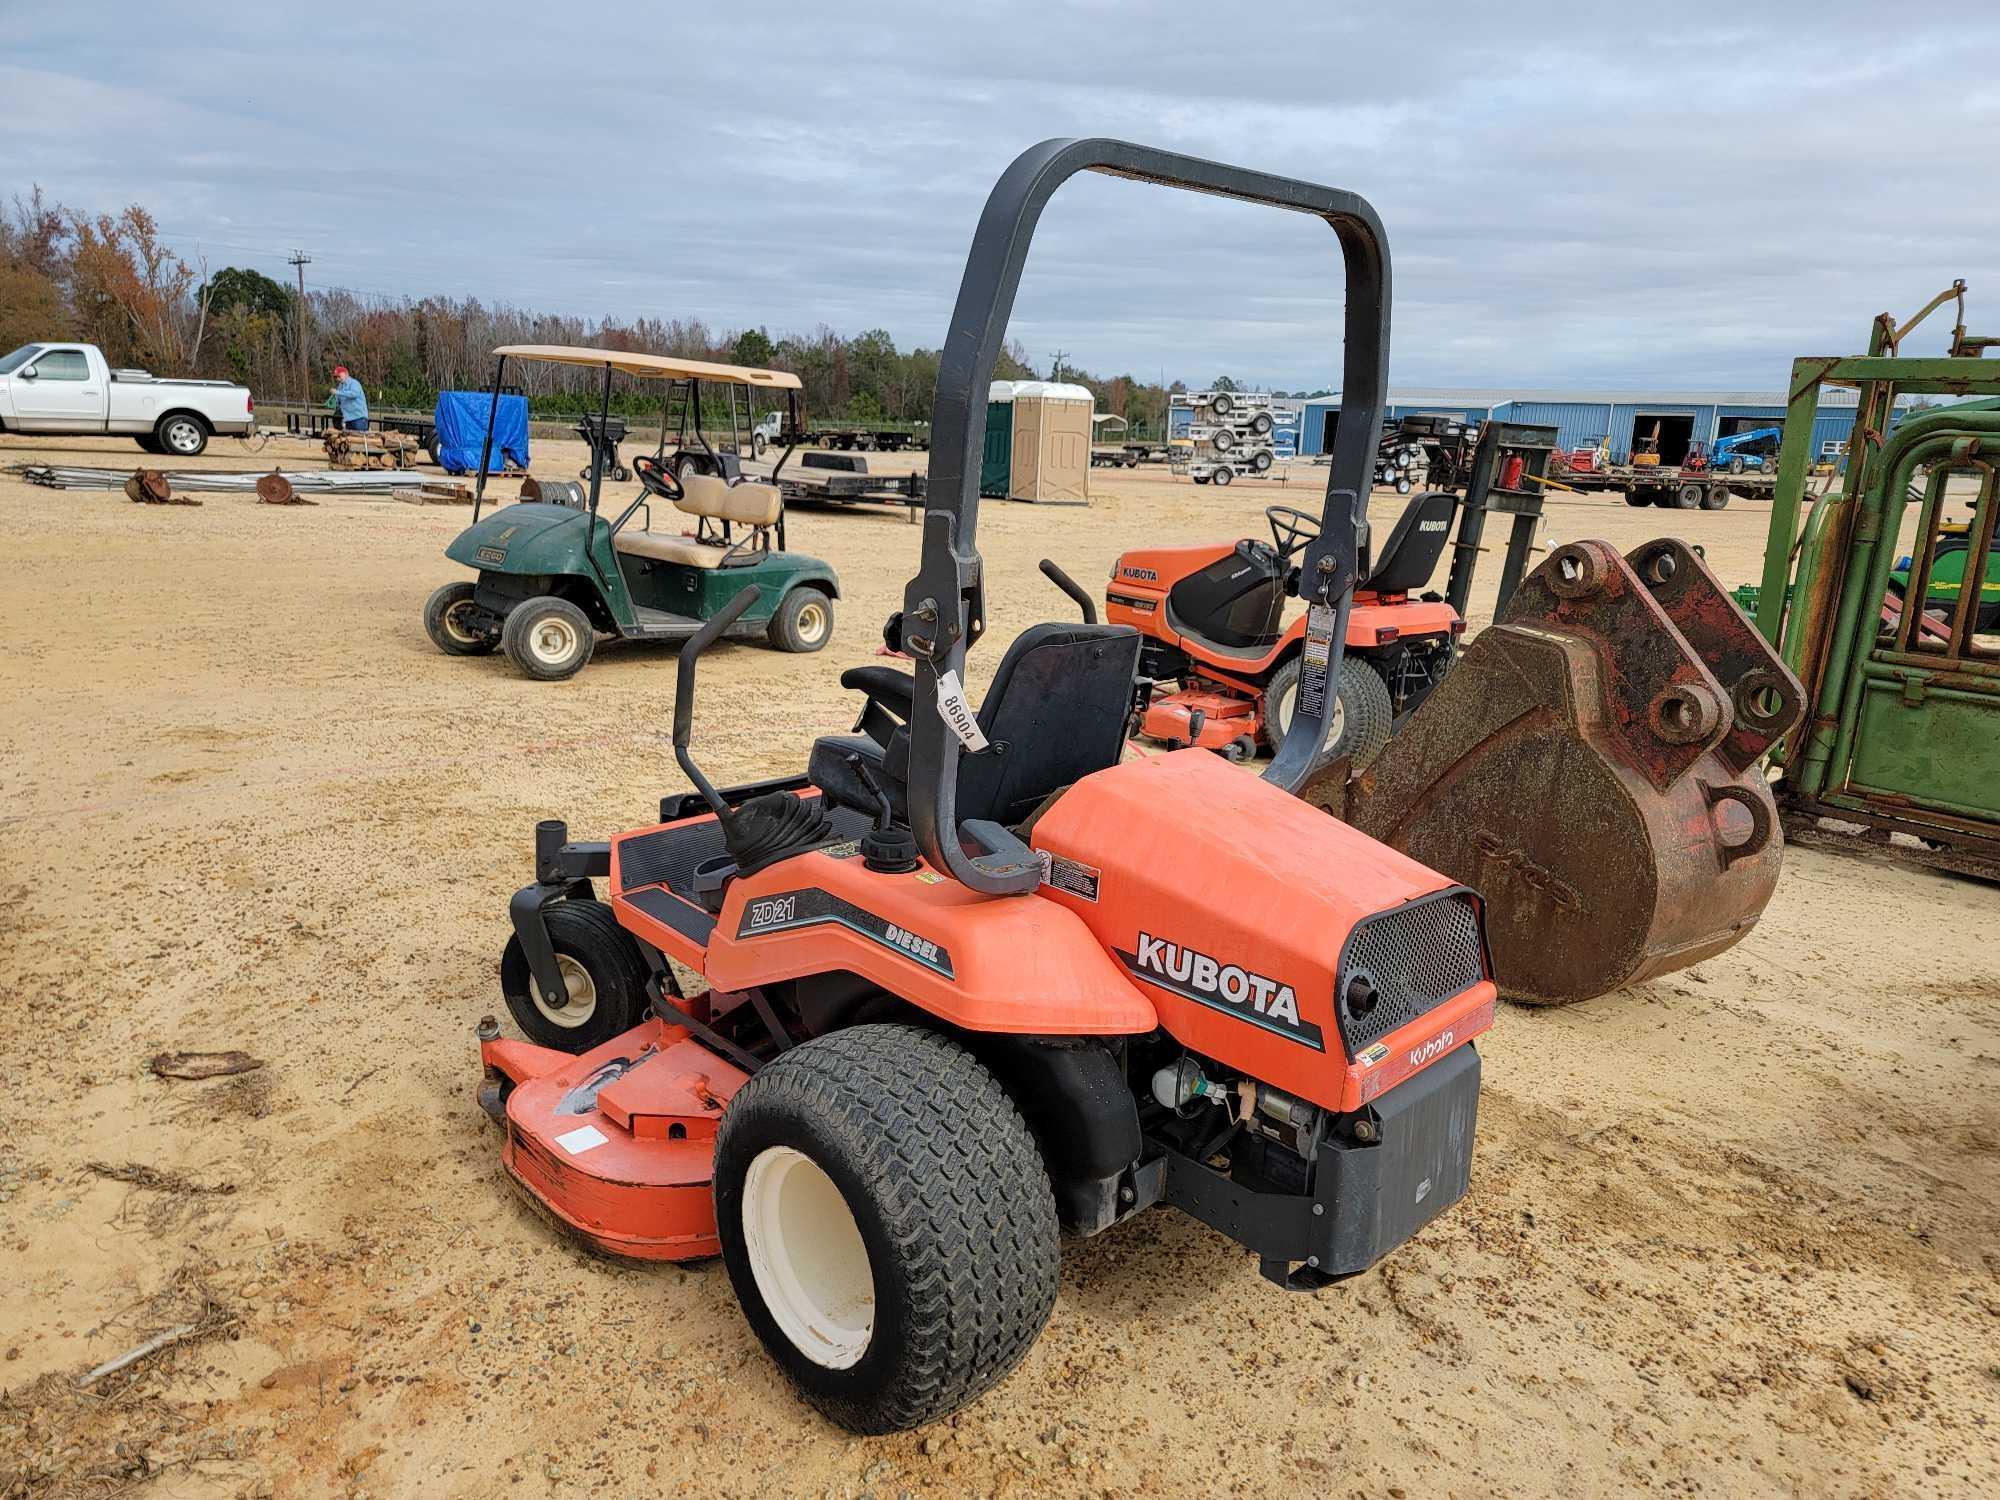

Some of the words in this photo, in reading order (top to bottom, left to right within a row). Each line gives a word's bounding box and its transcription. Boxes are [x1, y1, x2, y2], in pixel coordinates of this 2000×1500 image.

[1419, 520, 1448, 532] KUBOTA
[1123, 567, 1157, 581] KUBOTA
[945, 696, 975, 740] 86904
[750, 896, 796, 928] ZD21
[885, 924, 939, 963] DIESEL
[1137, 932, 1300, 1027] KUBOTA
[1409, 1031, 1454, 1066] Kubota
